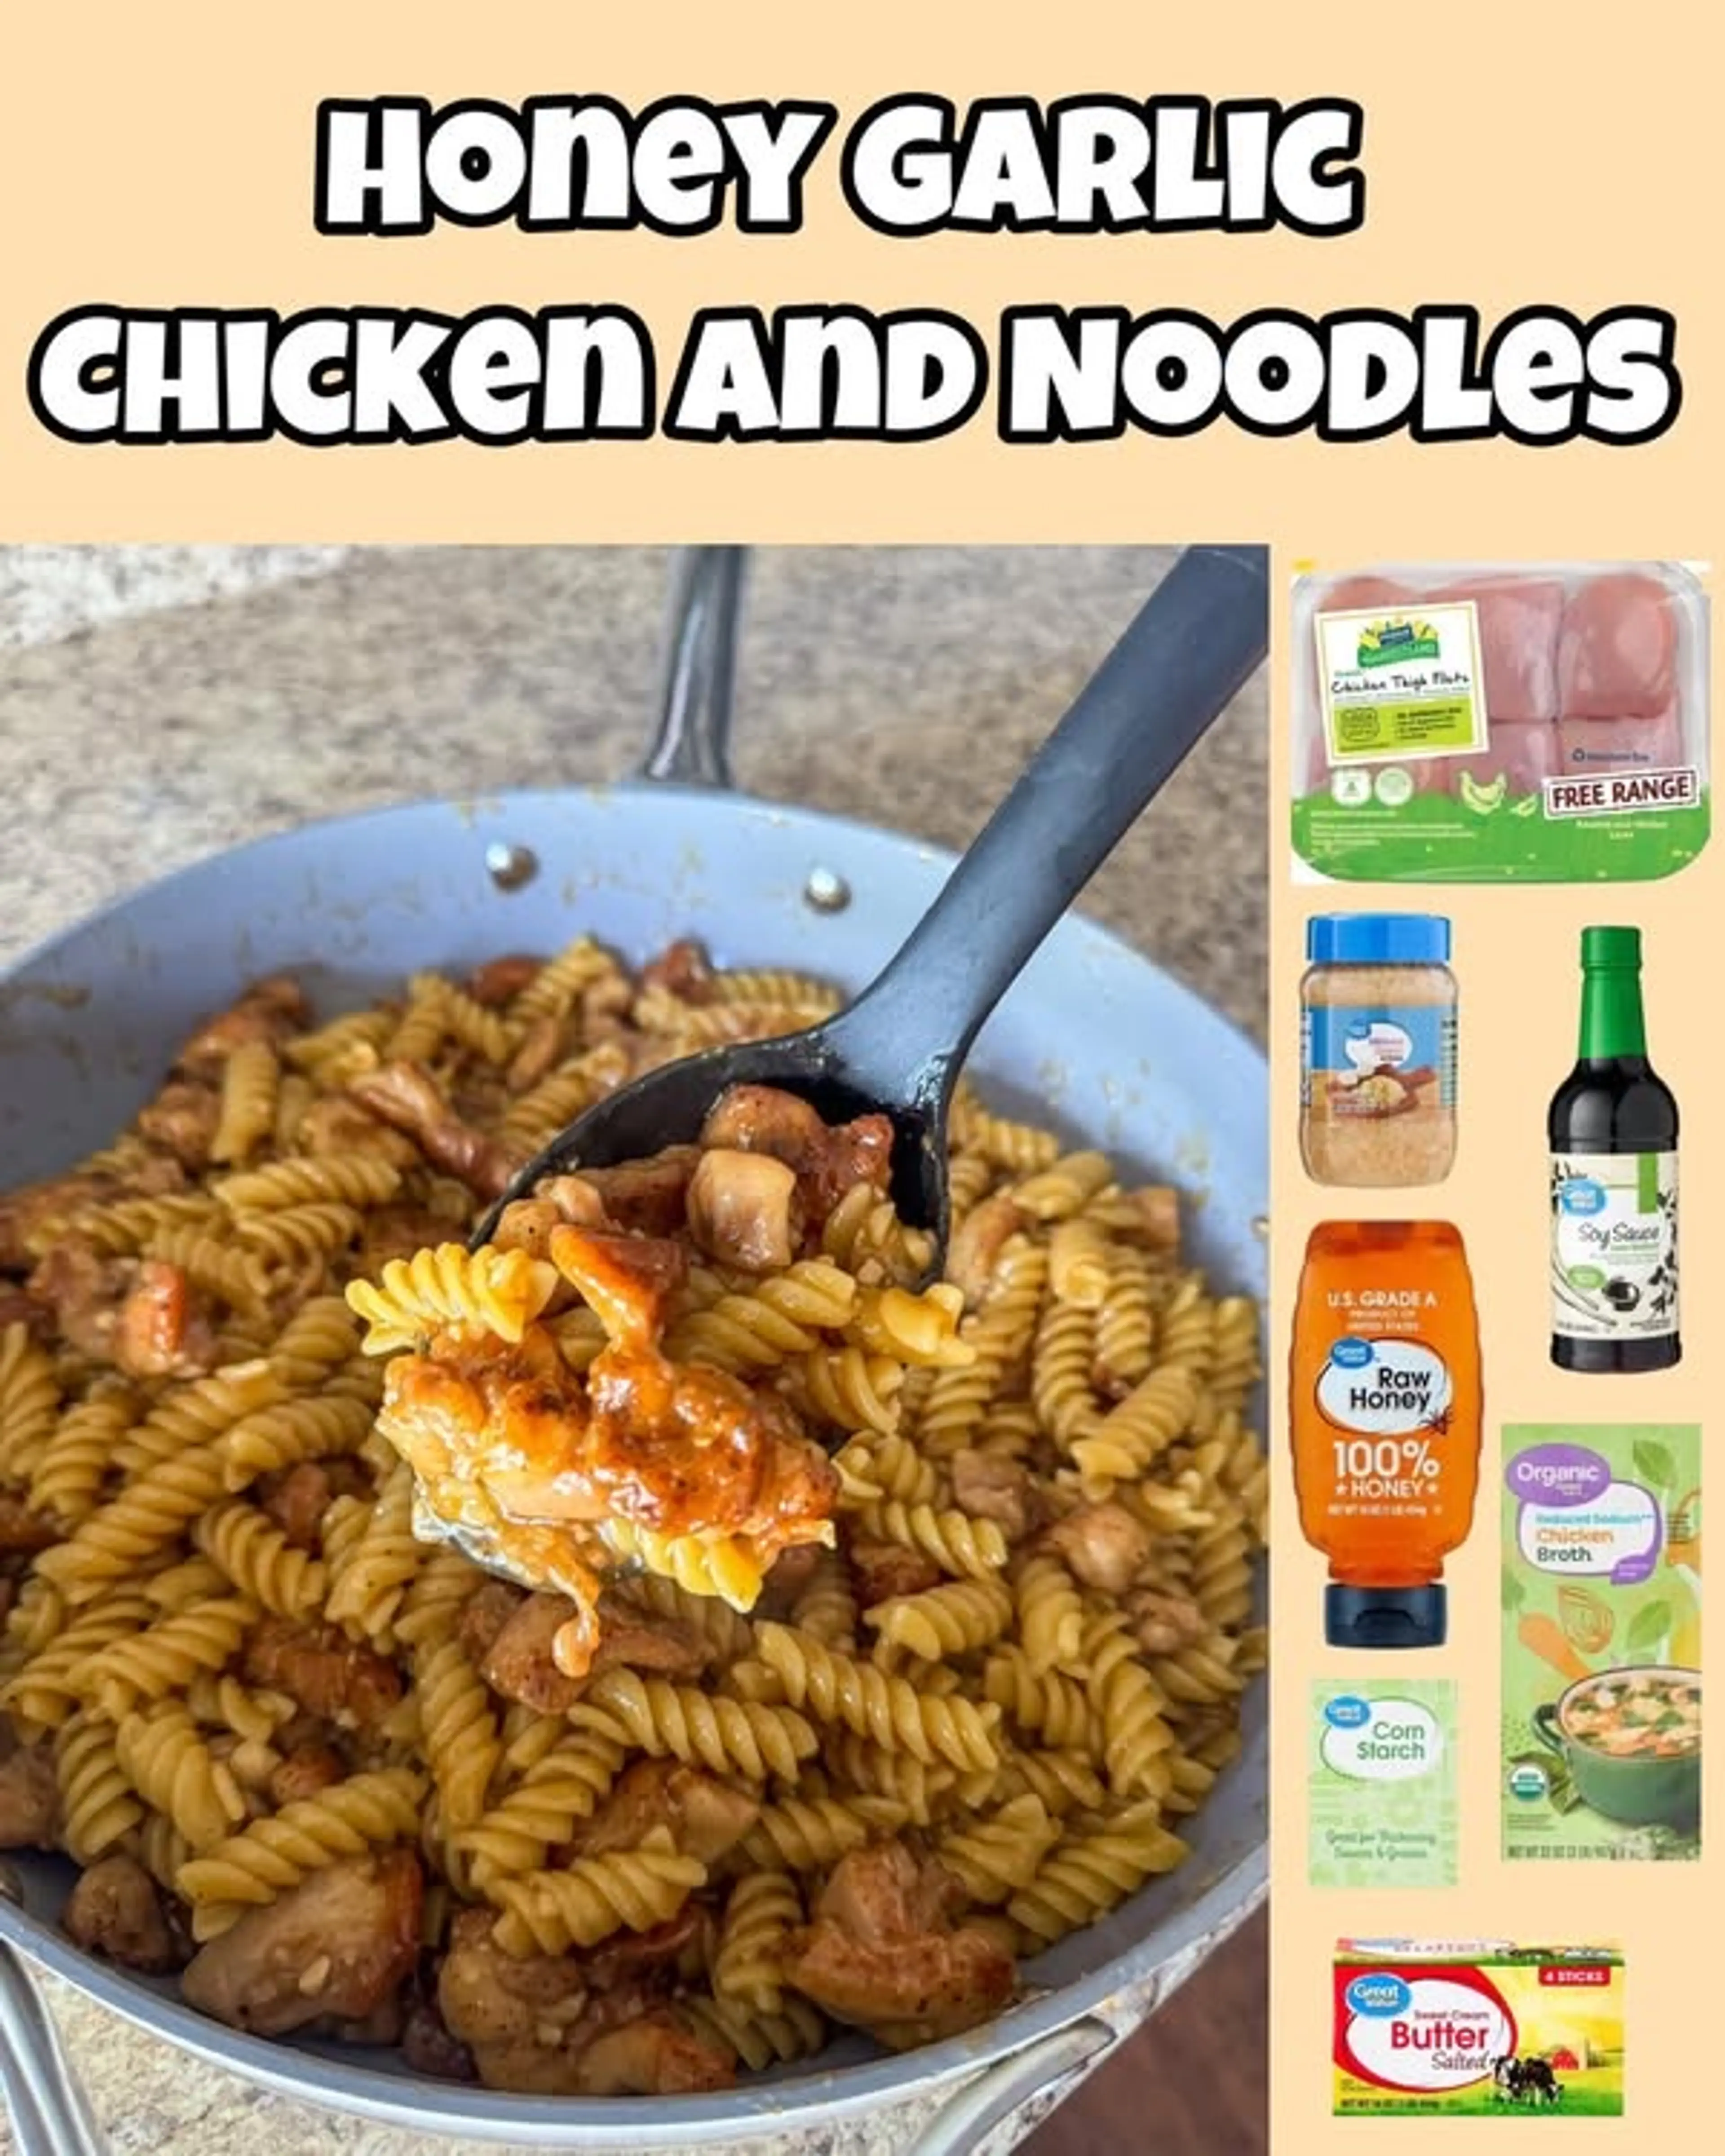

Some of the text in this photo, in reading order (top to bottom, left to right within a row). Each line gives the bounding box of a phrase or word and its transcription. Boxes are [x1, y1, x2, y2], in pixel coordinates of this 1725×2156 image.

[1392, 674, 1427, 691] Thigh
[1552, 776, 1690, 808] FREE RANGE
[1577, 1221, 1659, 1250] Soy Sauce
[1327, 1291, 1438, 1307] U.S. GRADE A
[1378, 1366, 1431, 1388] Raw
[1350, 1387, 1432, 1413] Honey
[1333, 1439, 1440, 1478] 100%
[1517, 1462, 1601, 1487] Organic
[1350, 1478, 1424, 1498] HONEY
[1536, 1527, 1614, 1543] Chicken
[1372, 1721, 1424, 1740] Corn
[1356, 1741, 1424, 1760] Starch
[1558, 1971, 1605, 1982] STICKS
[1353, 1984, 1399, 2000] Great
[1390, 2021, 1490, 2050] Butter
[1432, 2050, 1490, 2071] Salted
